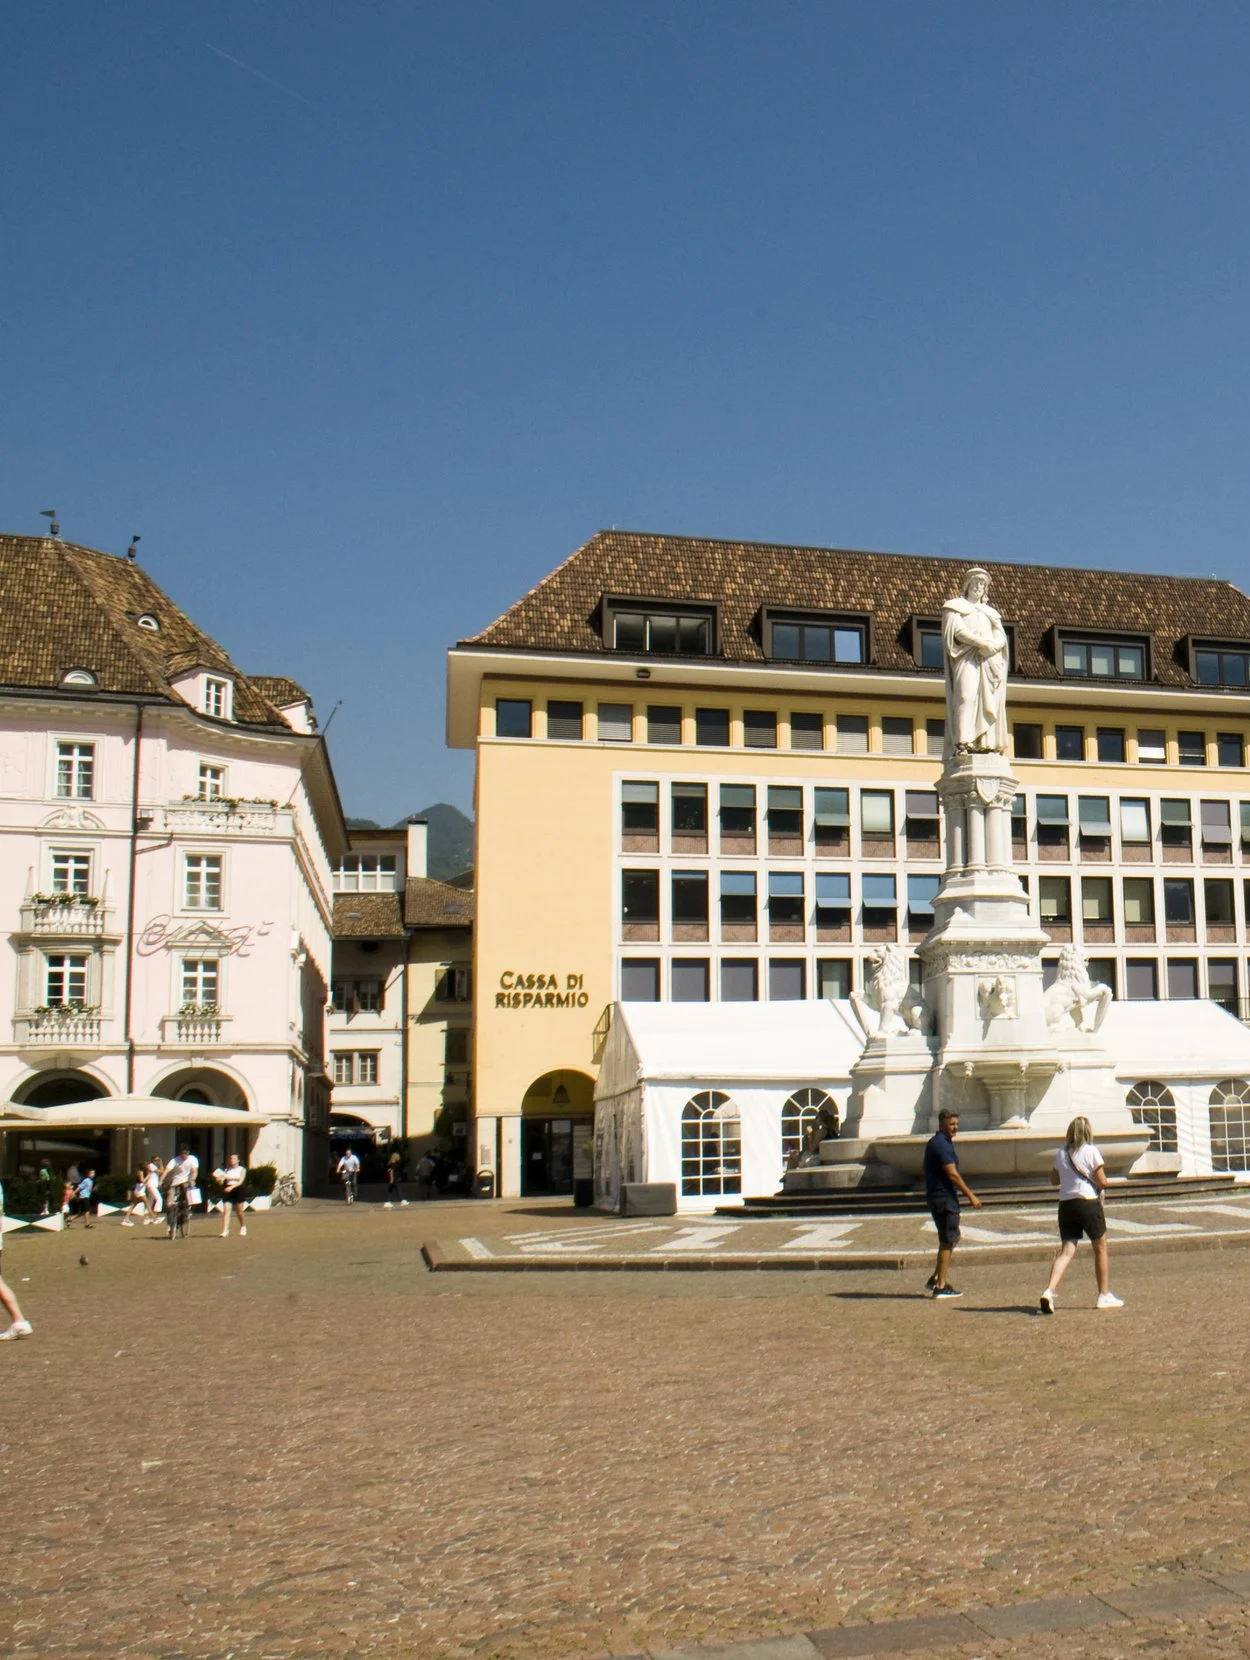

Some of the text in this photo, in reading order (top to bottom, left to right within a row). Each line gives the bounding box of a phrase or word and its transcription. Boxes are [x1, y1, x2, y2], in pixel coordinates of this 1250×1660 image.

[499, 971, 584, 990] CASSA DI
[495, 992, 589, 1009] RISPARMIO
